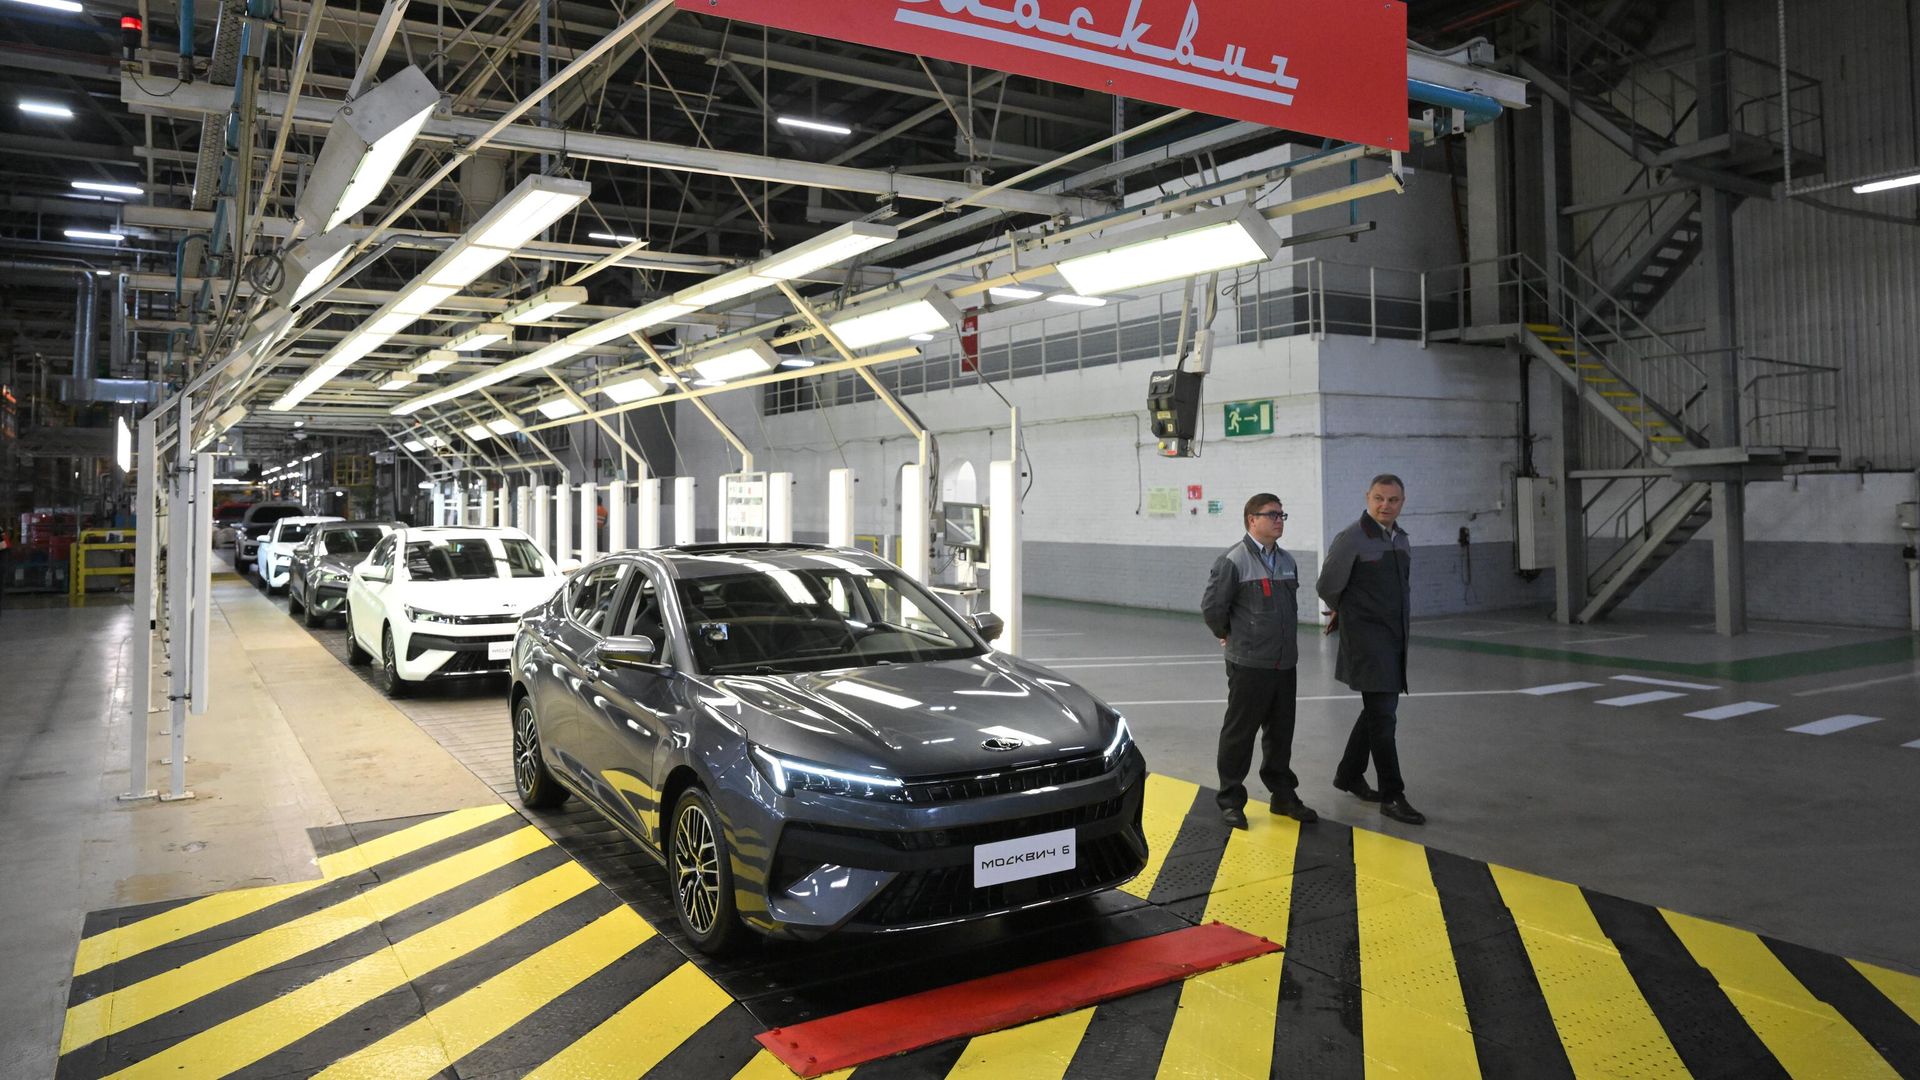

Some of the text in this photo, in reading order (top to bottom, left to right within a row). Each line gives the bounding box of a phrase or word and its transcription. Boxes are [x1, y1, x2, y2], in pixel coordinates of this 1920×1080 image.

[901, 0, 1299, 90] осквич
[981, 845, 1070, 870] МОСКВИЧ 6
